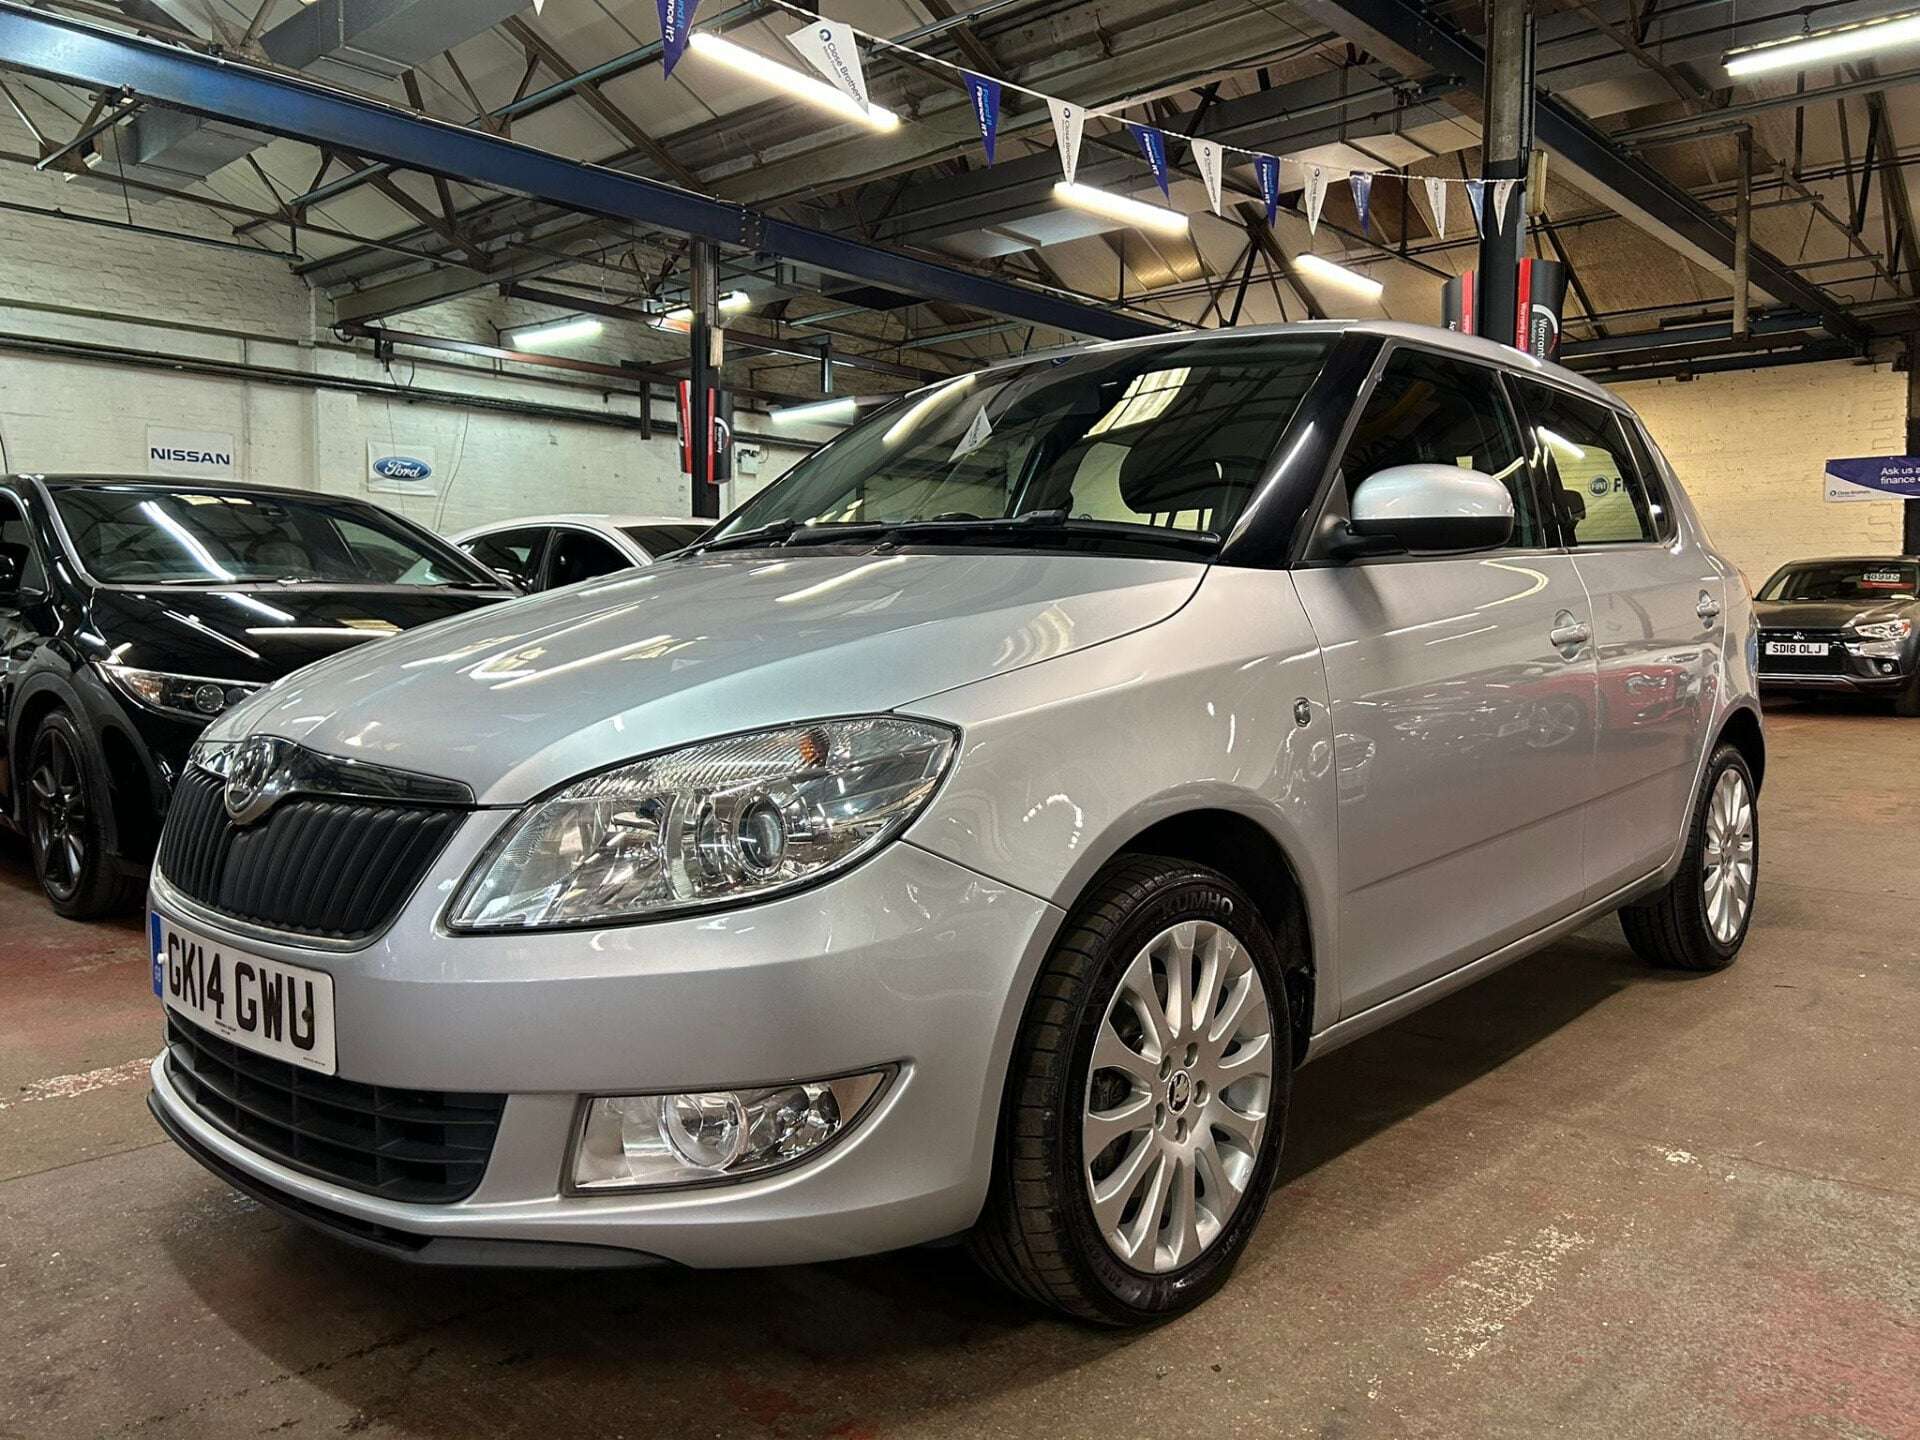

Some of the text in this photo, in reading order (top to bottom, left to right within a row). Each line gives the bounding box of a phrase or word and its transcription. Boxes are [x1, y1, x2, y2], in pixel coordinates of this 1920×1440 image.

[827, 42, 863, 101] Close Brothers
[976, 85, 985, 122] Finance
[151, 448, 230, 465] NISSAN
[384, 461, 421, 477] Ford
[1881, 467, 1900, 475] Ask
[1881, 475, 1916, 485] finance
[1772, 643, 1822, 654] SD18 OLJ
[168, 931, 315, 1051] GK14 GWU
